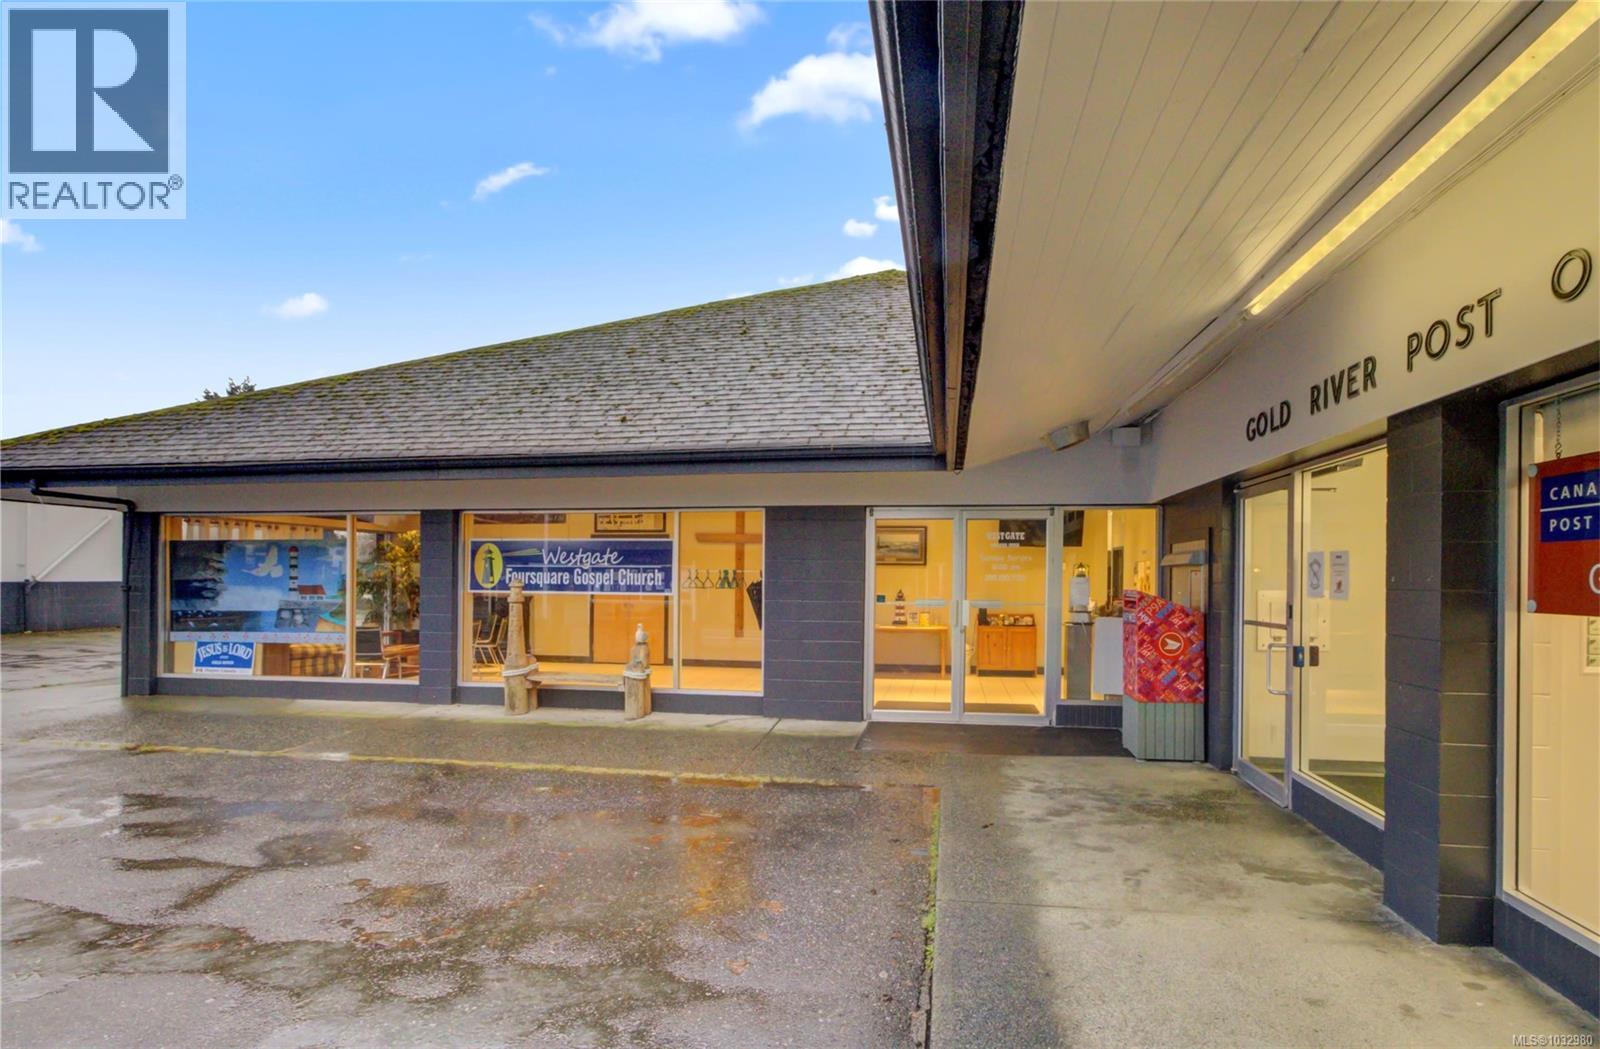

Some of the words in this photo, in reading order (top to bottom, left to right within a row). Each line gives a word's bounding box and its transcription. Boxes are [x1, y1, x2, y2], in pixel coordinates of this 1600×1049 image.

[1246, 400, 1292, 442] GOLD
[1310, 355, 1377, 416] RIVER
[1406, 287, 1503, 373] POST
[1551, 248, 1593, 302] O
[1549, 482, 1598, 502] CANA
[1549, 515, 1593, 534] POST
[541, 546, 624, 569] Westgate
[505, 568, 570, 587] Foursquare
[574, 568, 613, 588] Gospel
[617, 568, 663, 586] Church
[197, 642, 222, 663] JESUS
[229, 642, 253, 660] LORD
